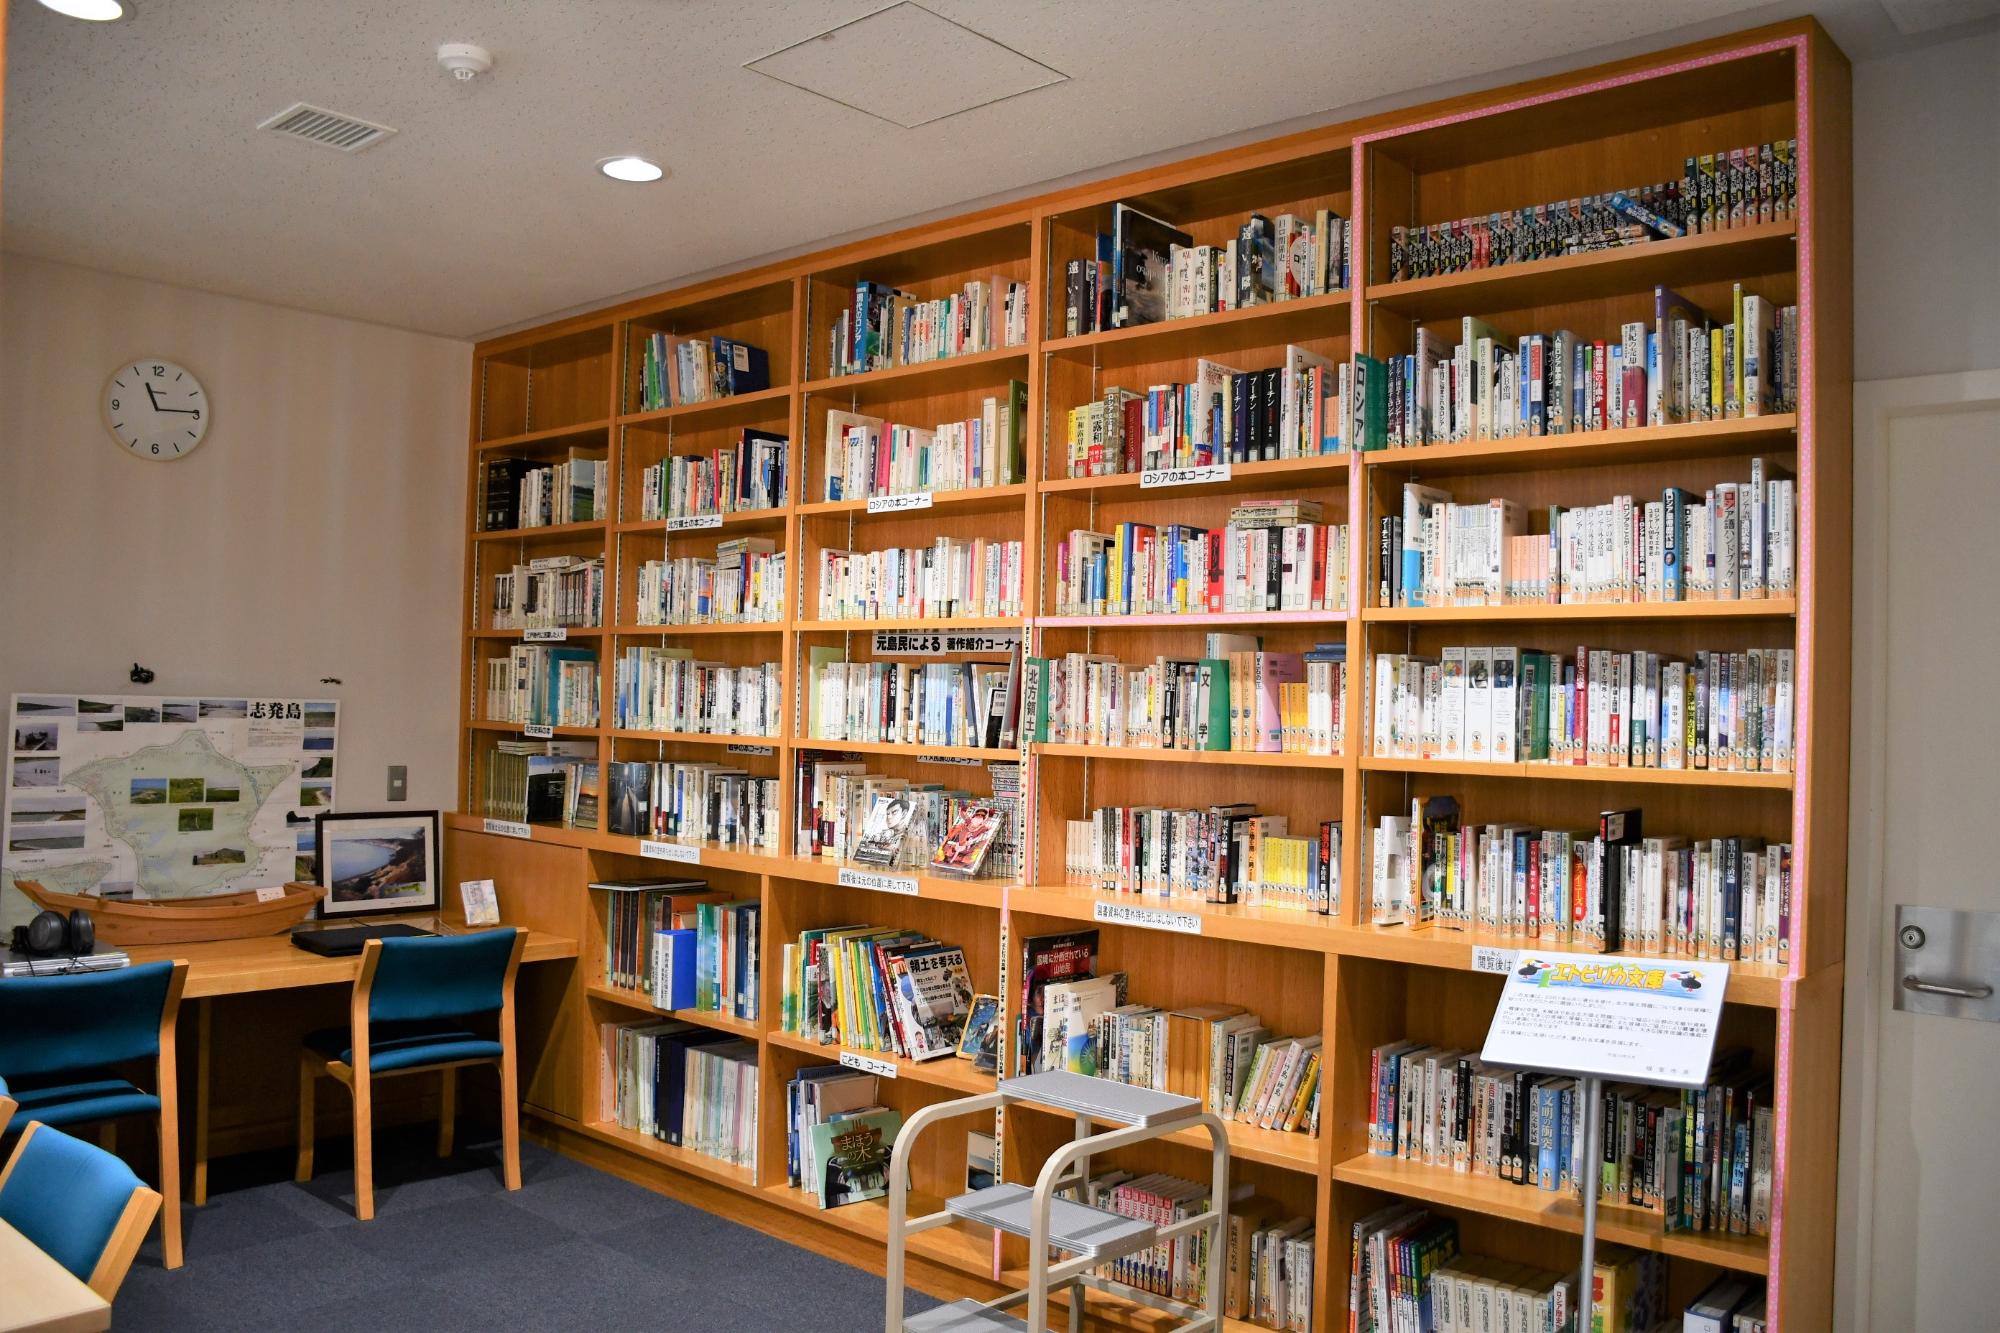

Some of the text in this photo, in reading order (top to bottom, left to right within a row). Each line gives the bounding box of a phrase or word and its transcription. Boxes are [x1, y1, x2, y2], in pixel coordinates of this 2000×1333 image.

[1628, 325, 1637, 365] 世紀の売却
[152, 365, 165, 377] 12
[1266, 371, 1275, 408] プーチン
[1503, 362, 1511, 400] KGB帝国
[1234, 377, 1242, 412] プーチン
[1249, 375, 1258, 411] プーチン
[1354, 366, 1365, 437] ロシア
[111, 399, 120, 410] 9
[192, 410, 200, 420] 3
[151, 443, 160, 455] 6
[1143, 470, 1225, 485] ロシアの本コーナー
[869, 496, 929, 510] ロシアの本コーナー
[668, 517, 721, 529] 北方領土の本コーナー
[1724, 491, 1736, 579] ロシア語ハンドブック
[876, 635, 941, 652] 元島民による
[946, 637, 1021, 651] 著作紹介コーナー
[1026, 668, 1038, 732] 北方領土
[249, 702, 301, 720] 志発島
[910, 954, 963, 974] 領土を考える
[1477, 955, 1512, 972] 閲覧後は
[1550, 962, 1666, 990] エトピリカ文庫
[841, 1053, 895, 1074] こども コーナー
[1542, 1095, 1553, 1151] 文明の衝突
[841, 1132, 875, 1150] まほう
[847, 1147, 872, 1161] の木
